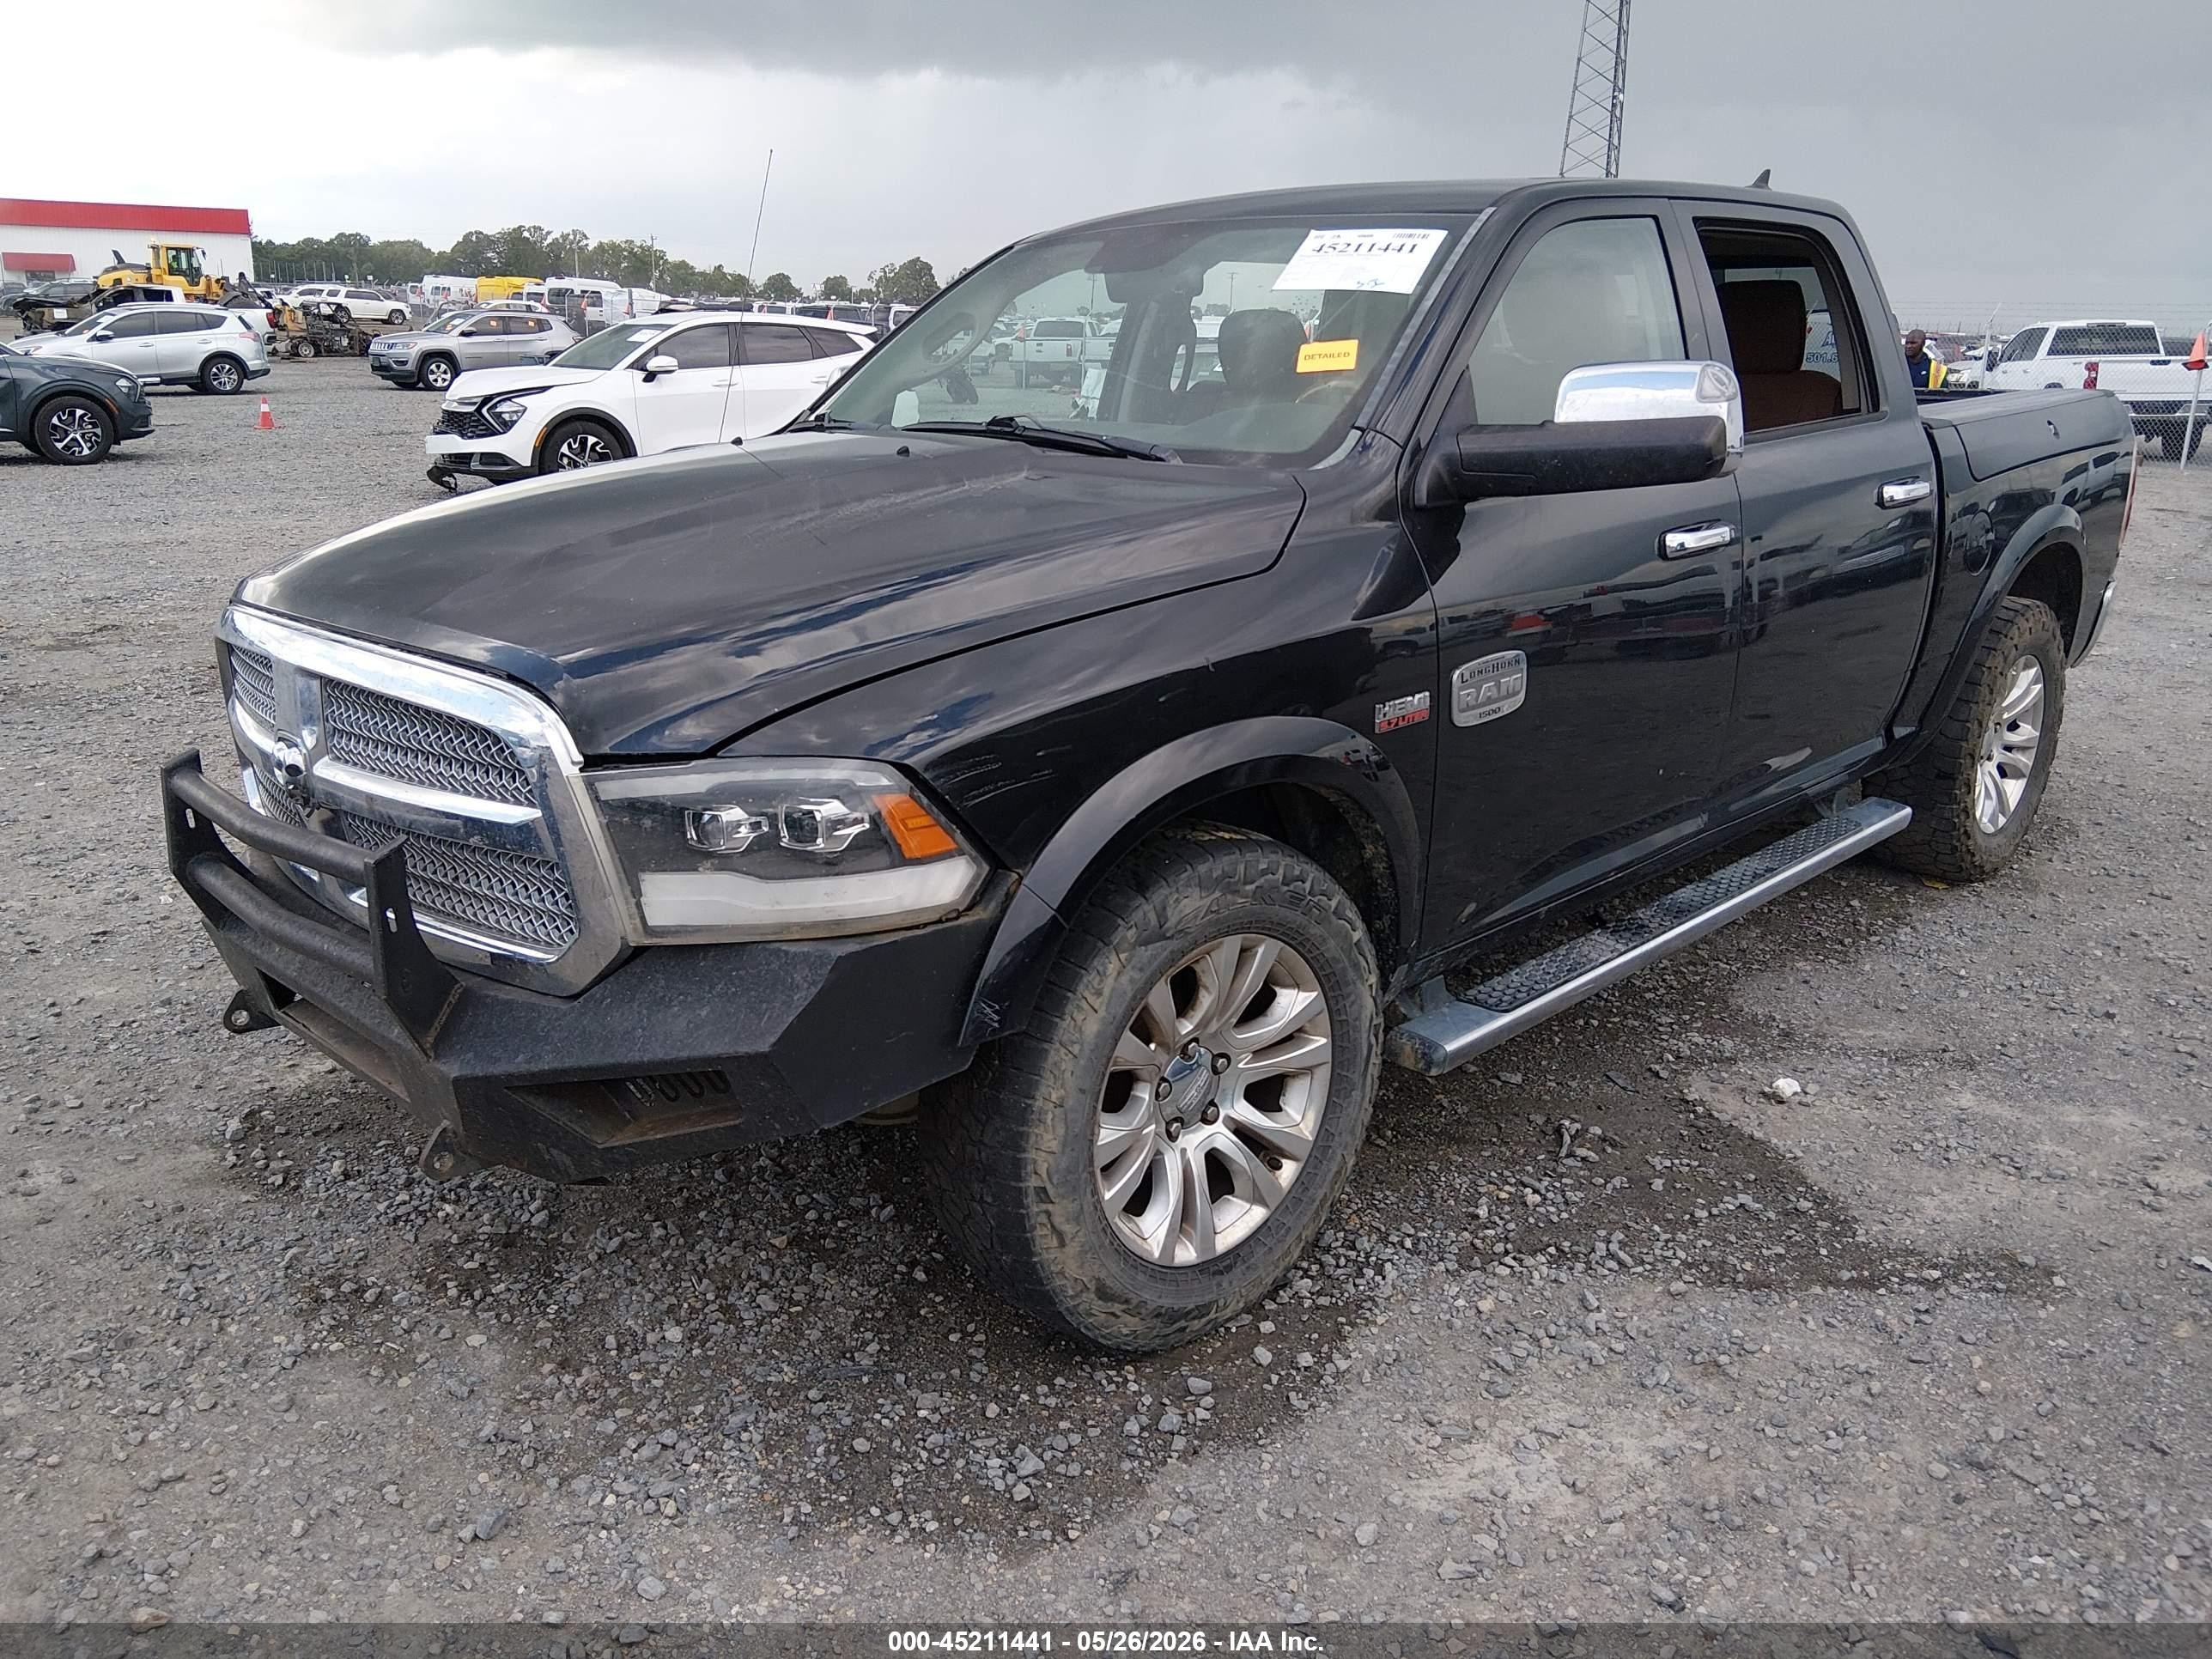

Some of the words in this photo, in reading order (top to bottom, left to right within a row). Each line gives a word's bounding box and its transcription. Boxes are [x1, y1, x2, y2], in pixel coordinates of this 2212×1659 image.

[1312, 242, 1419, 254] 45211441
[1304, 350, 1351, 362] DETAILED
[1459, 673, 1522, 710] RAM
[1375, 690, 1430, 721] HEMI
[1479, 707, 1501, 719] 1500
